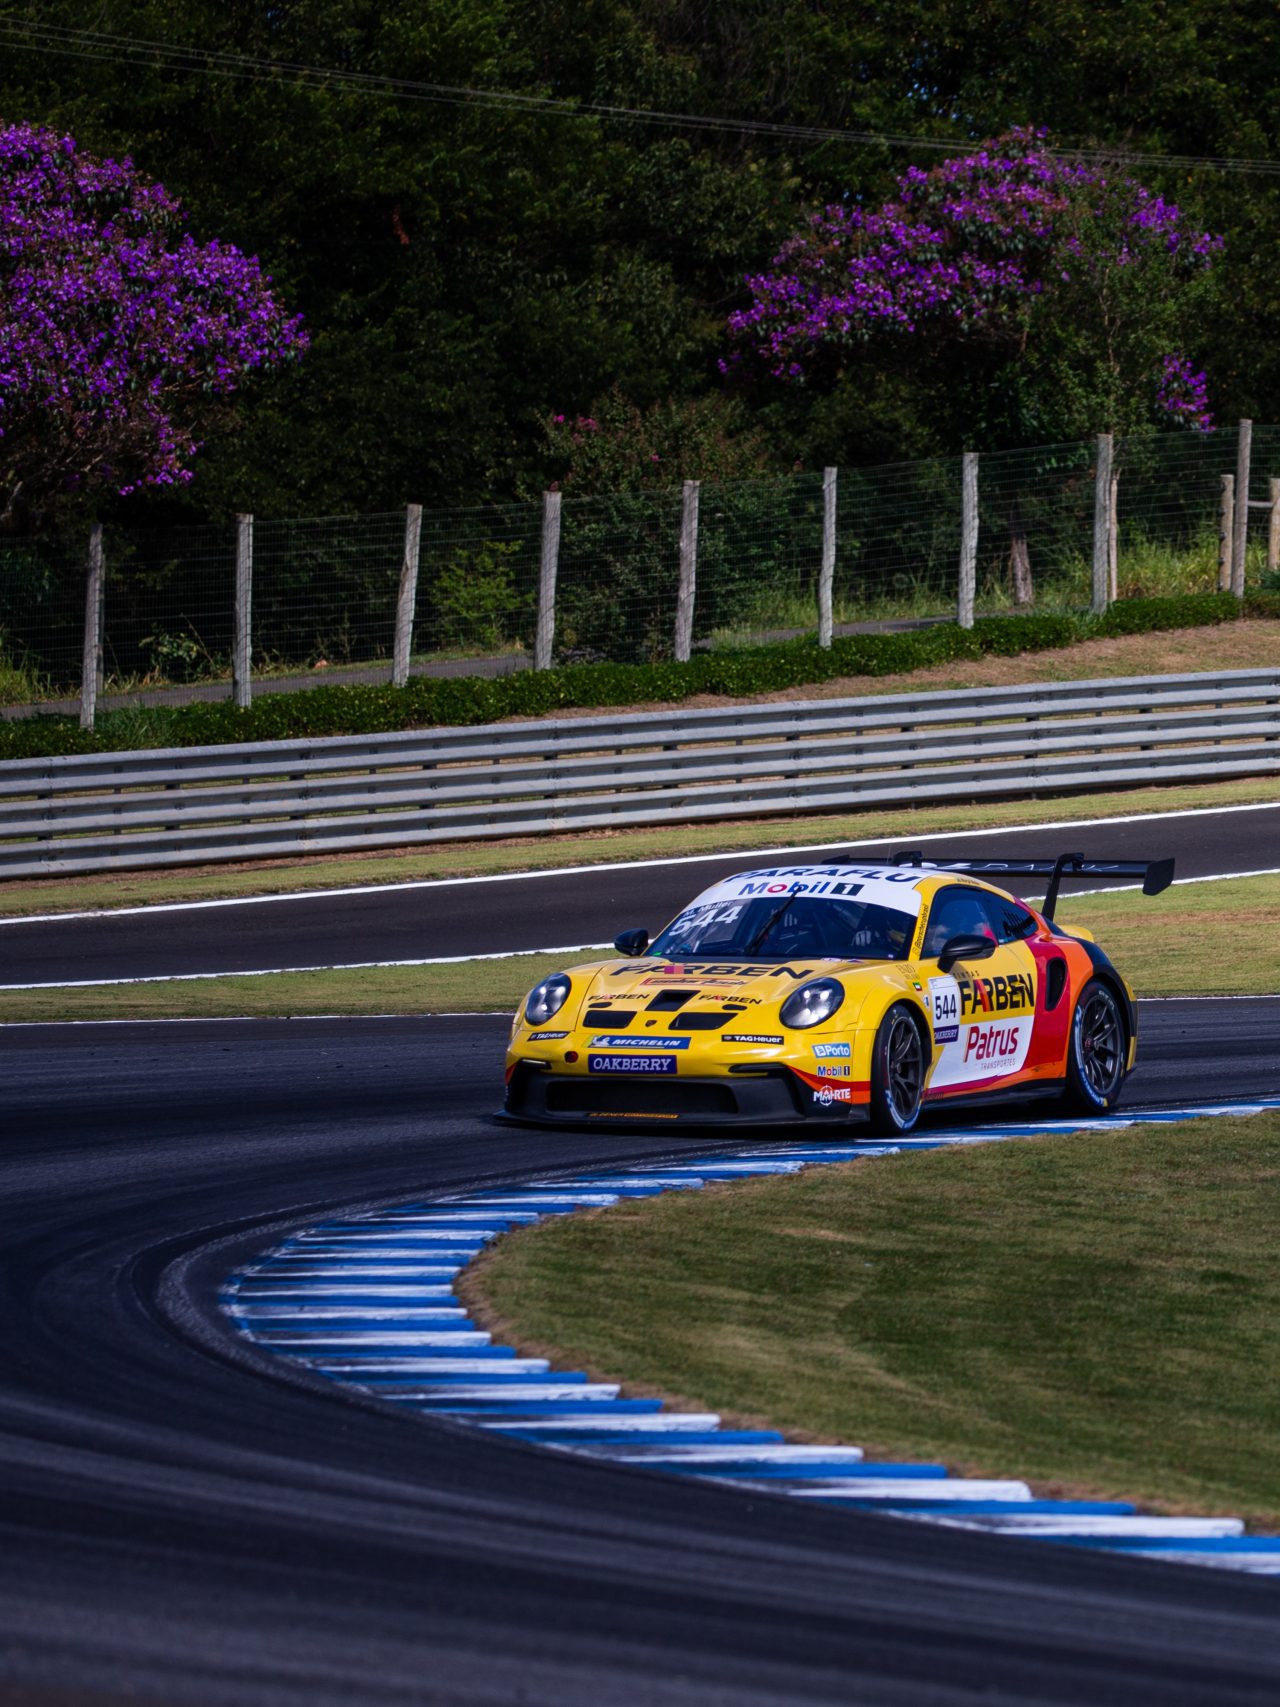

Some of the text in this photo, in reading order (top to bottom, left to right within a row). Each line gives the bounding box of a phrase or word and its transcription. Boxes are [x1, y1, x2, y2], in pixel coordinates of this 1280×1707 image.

[723, 868, 924, 883] PARAFLU
[738, 882, 831, 894] Mobil
[668, 905, 743, 936] 544
[610, 965, 815, 979] FARBEN
[588, 993, 650, 1001] FARBEN
[699, 994, 762, 1005] FARBEN
[957, 973, 1035, 1016] FARBEN
[935, 994, 957, 1020] 544
[612, 1038, 681, 1047] MICHELIN
[964, 1026, 1019, 1063] Patrus
[825, 1045, 850, 1056] Porto
[593, 1057, 672, 1071] OAKBERRY
[817, 1066, 842, 1077] Mobil
